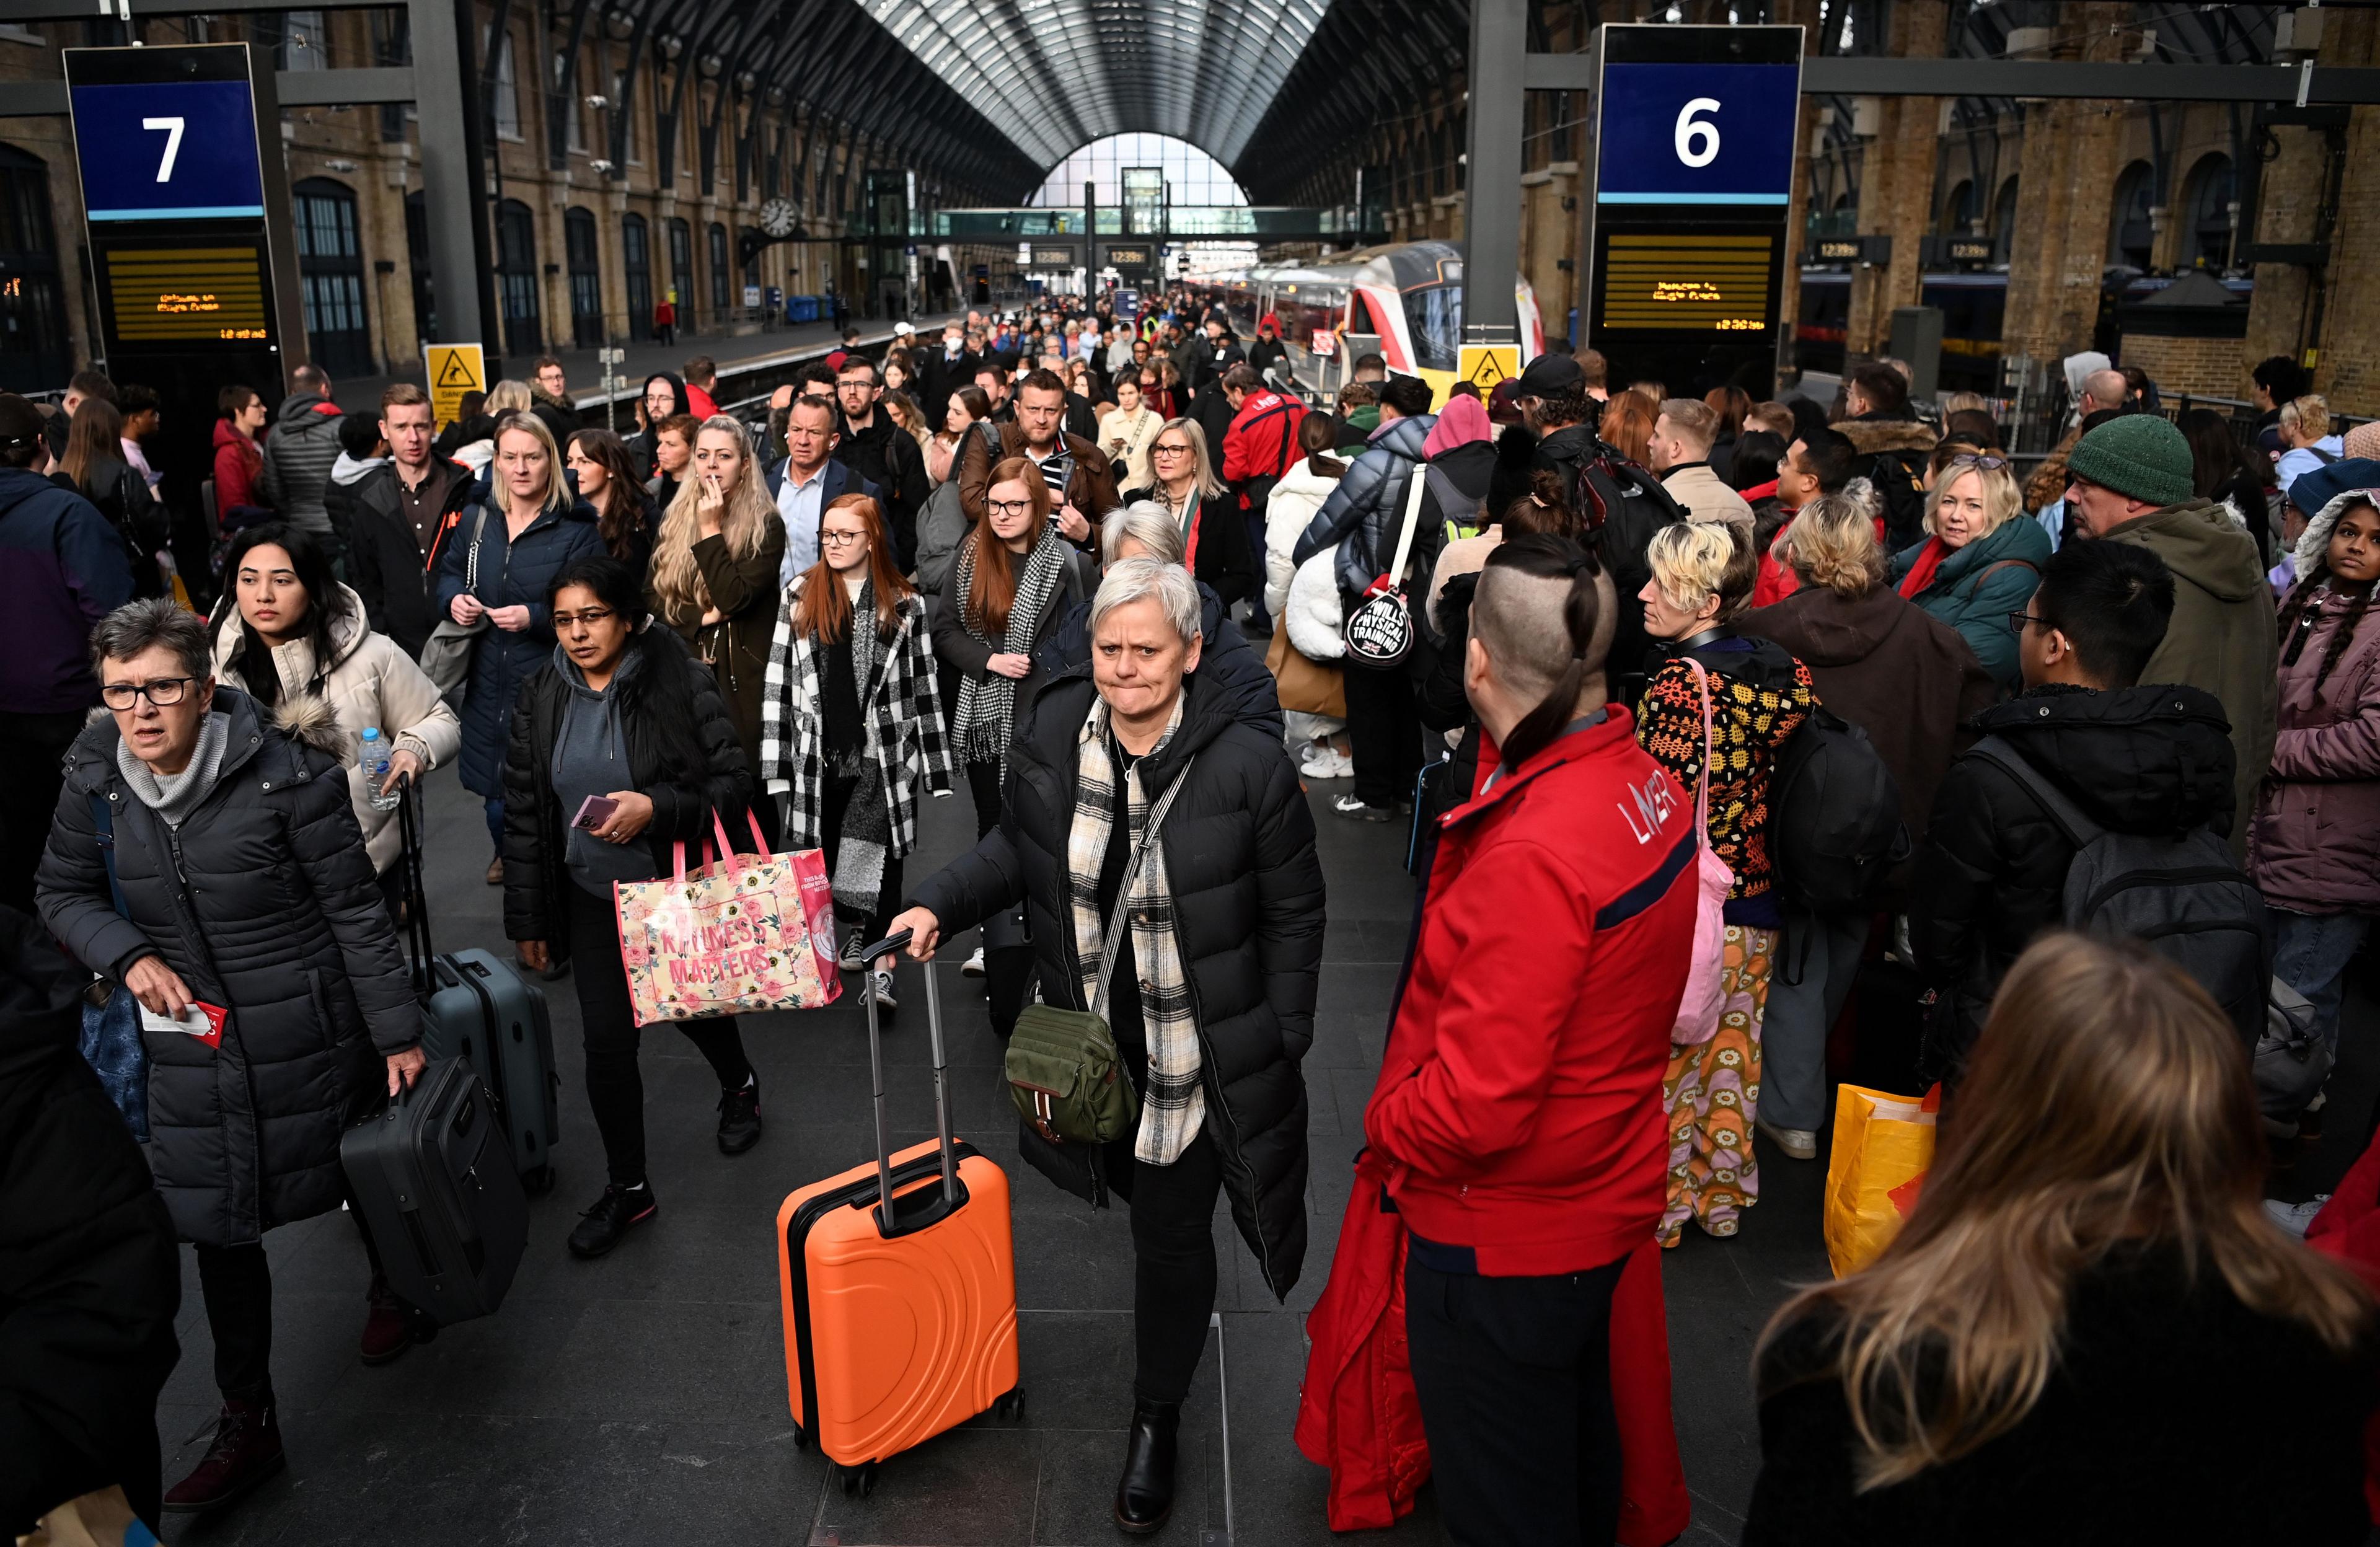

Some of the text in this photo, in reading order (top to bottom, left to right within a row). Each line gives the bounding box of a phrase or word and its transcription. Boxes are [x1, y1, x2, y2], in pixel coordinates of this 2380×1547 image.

[143, 117, 185, 182] 7
[1675, 97, 1721, 167] 6
[1354, 626, 1398, 653] TRAINING
[1356, 614, 1403, 643] PHYSICAL
[1616, 769, 1678, 845] LNER
[669, 945, 771, 984] MATTERS
